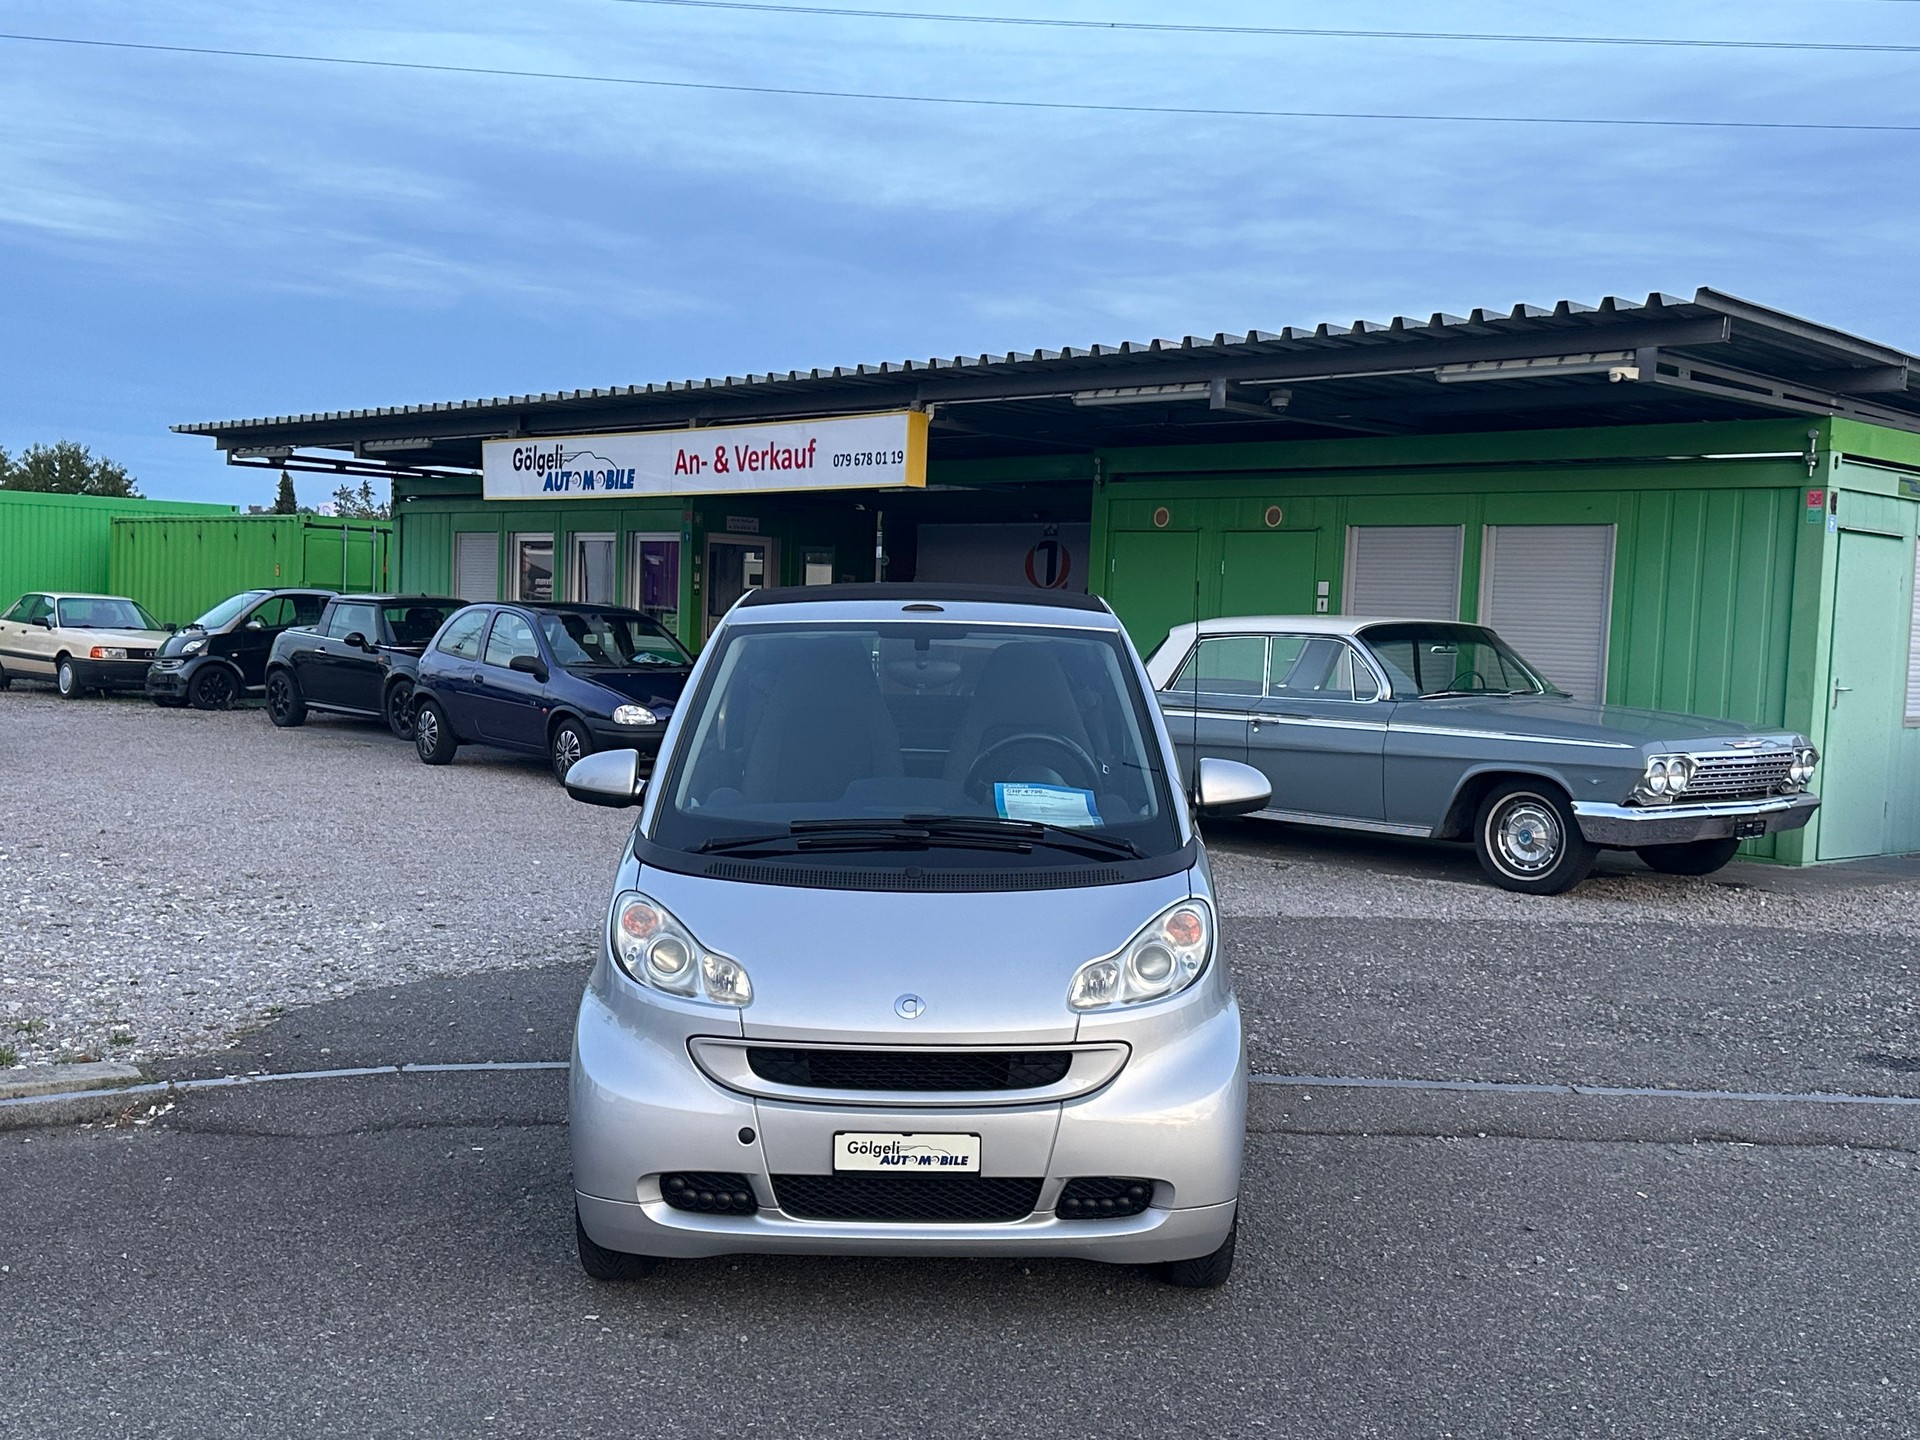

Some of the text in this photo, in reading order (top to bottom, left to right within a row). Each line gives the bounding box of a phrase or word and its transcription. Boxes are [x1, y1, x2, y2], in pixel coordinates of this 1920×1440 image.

[513, 444, 563, 477] Gölgeli
[675, 438, 816, 475] An- & Verkauf
[833, 450, 903, 467] 079 678 01 19
[847, 1141, 900, 1157] Gölgeli
